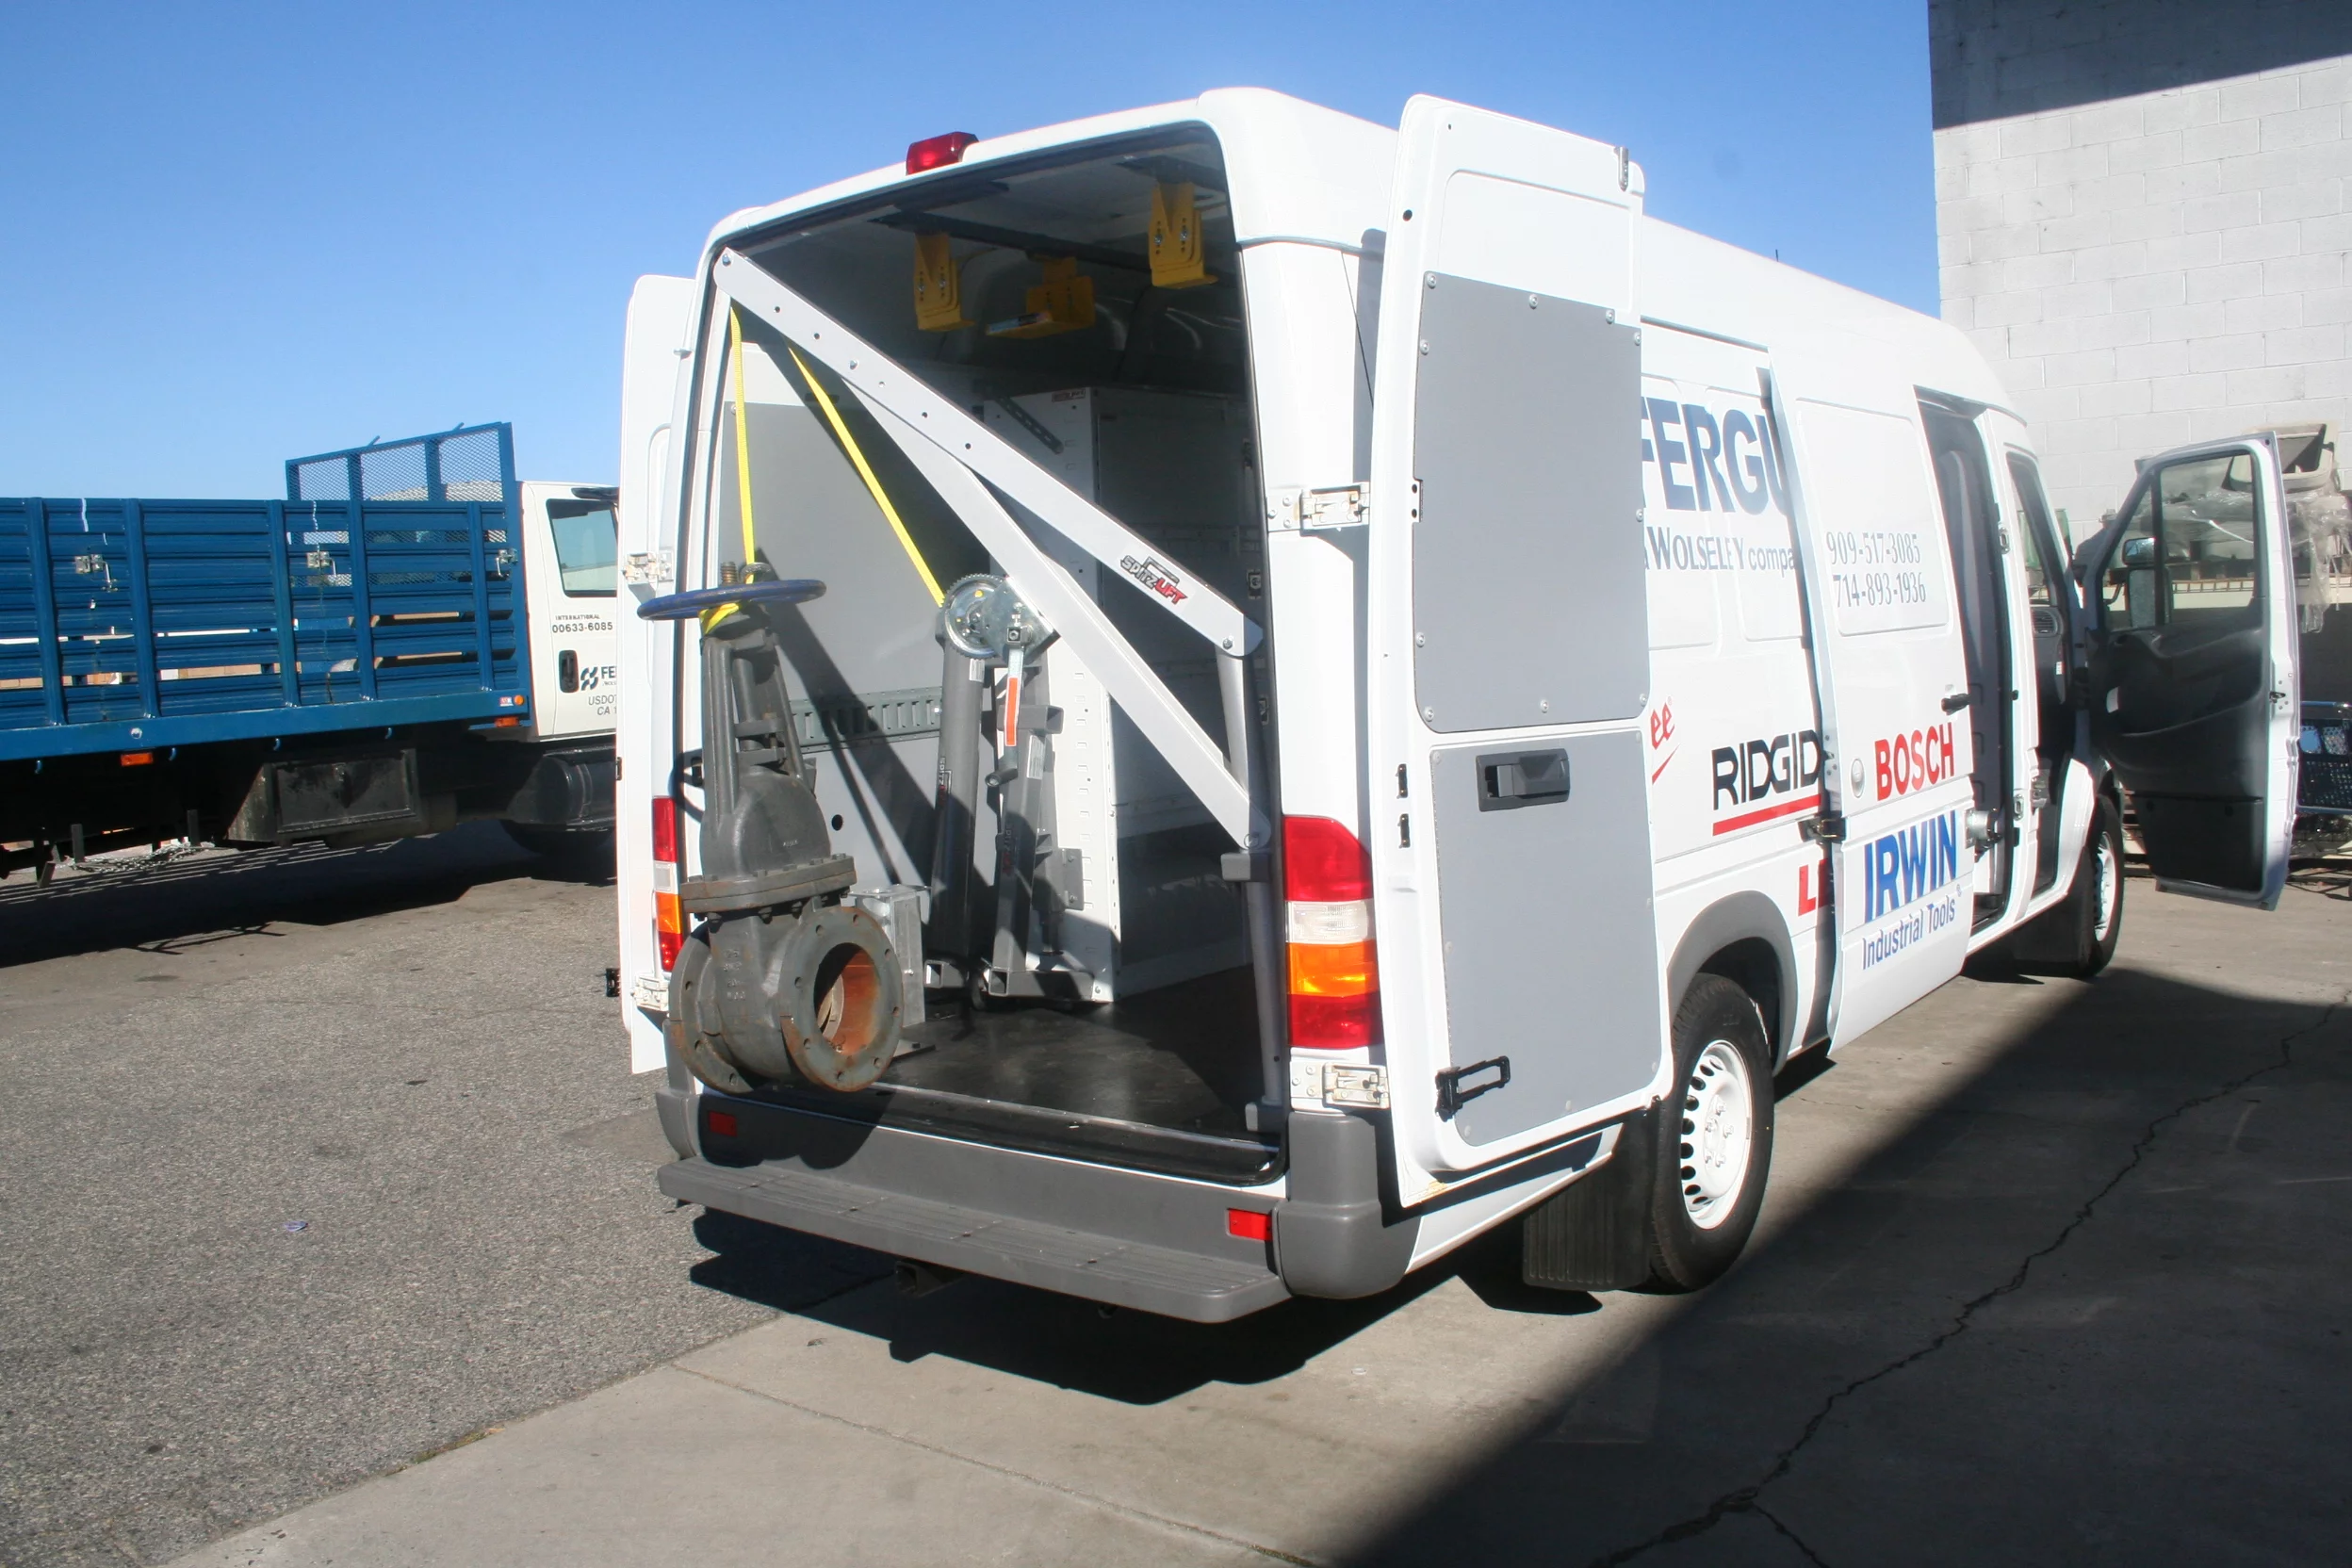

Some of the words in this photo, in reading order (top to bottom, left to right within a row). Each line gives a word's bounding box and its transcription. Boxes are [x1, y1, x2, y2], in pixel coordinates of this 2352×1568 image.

[1826, 531, 1920, 564] 909-517-3085
[1833, 572, 1926, 608] 714-893-1936
[601, 666, 617, 679] FE
[596, 706, 611, 716] CA
[1711, 729, 1821, 810] RIDGID
[1874, 722, 1954, 801] BOSCH
[1865, 810, 1956, 923] IRWIN
[1862, 908, 1924, 971] Industrial
[1926, 895, 1955, 934] Tools
